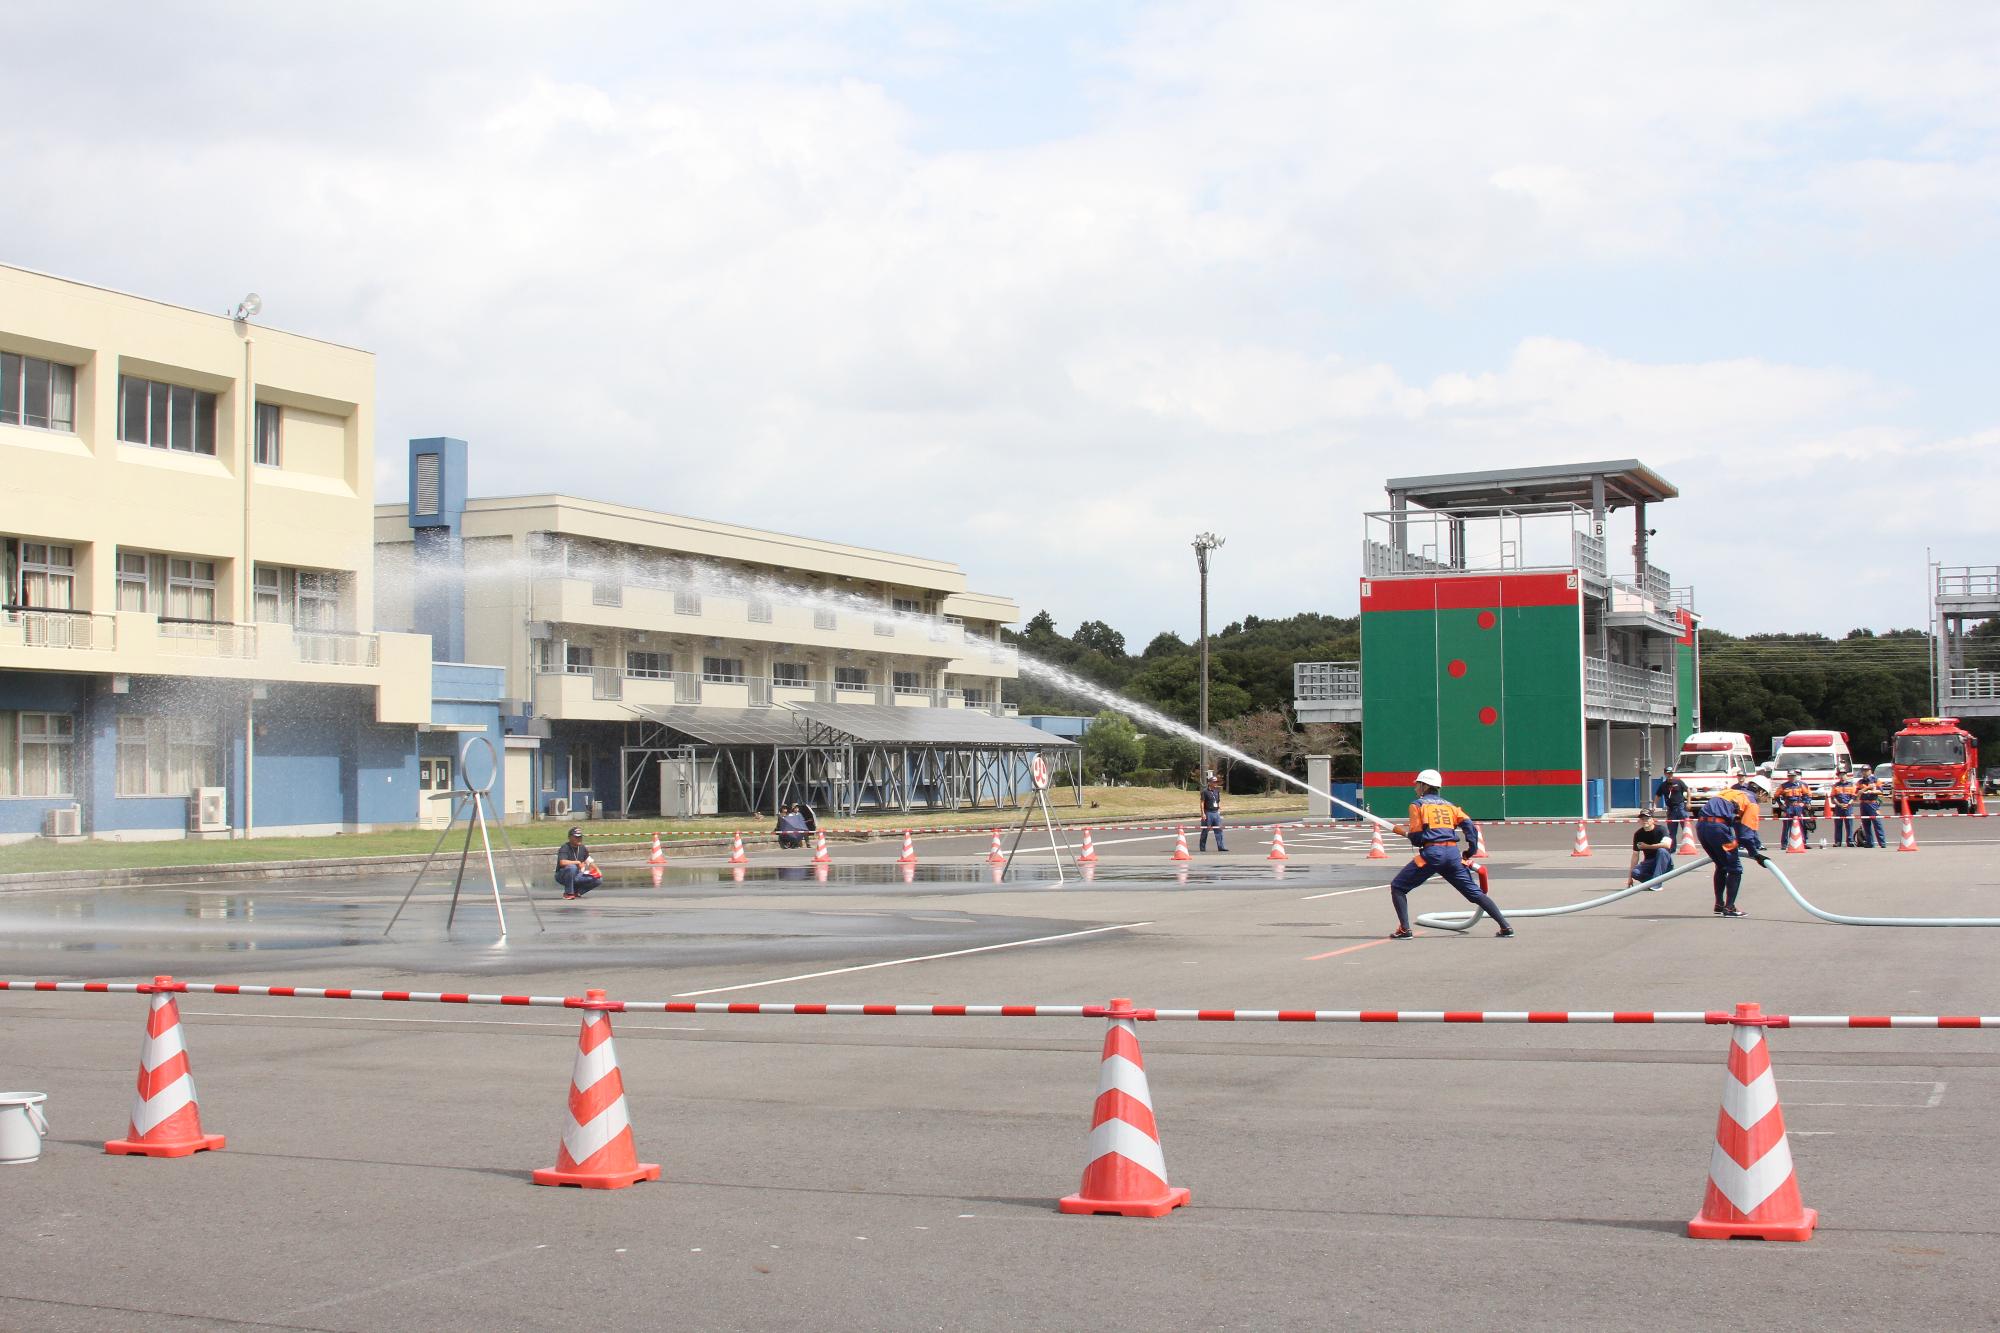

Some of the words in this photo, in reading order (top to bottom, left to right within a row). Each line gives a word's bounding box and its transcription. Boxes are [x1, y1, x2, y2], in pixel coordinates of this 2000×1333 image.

[1596, 525, 1603, 535] B
[1568, 576, 1577, 588] 2
[1432, 808, 1452, 825] 指
